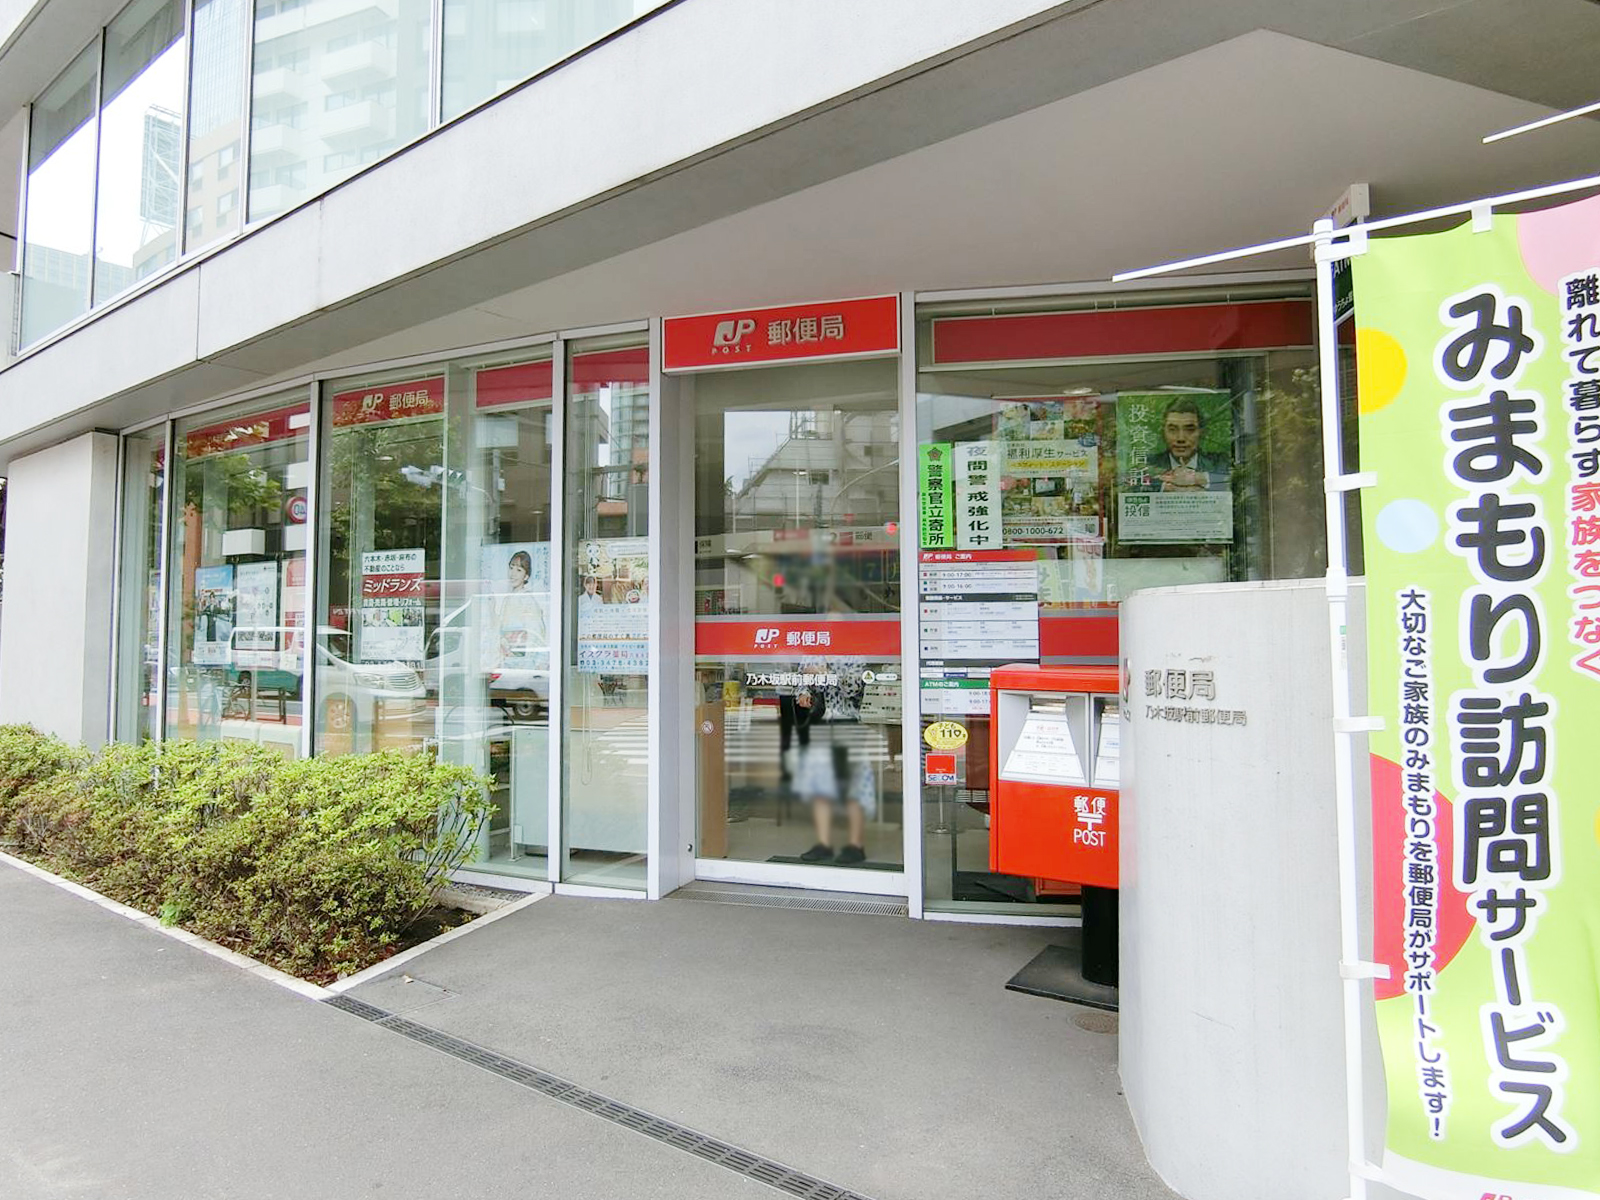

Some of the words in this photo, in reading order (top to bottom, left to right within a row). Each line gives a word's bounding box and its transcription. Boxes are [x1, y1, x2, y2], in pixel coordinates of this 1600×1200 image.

[713, 319, 756, 346] JP
[767, 315, 845, 346] 郵便局
[711, 344, 752, 354] POST
[389, 390, 430, 411] 郵便局
[1129, 404, 1151, 486] 投資信託
[927, 464, 944, 546] 警察官立寄所
[966, 446, 990, 546] 夜間警戒強化中
[363, 577, 422, 593] ミッドランズ
[755, 628, 780, 643] JP
[786, 631, 831, 646] 郵便局
[746, 672, 838, 687] 乃木坂駅前郵便局
[1144, 668, 1216, 701] 郵便局
[1145, 704, 1248, 727] 乃木坂駅前郵便局
[1442, 292, 1567, 1142] みまもり訪問サービス
[928, 774, 955, 782] SECOM
[1073, 796, 1107, 815] 郵便
[1073, 828, 1107, 847] POST
